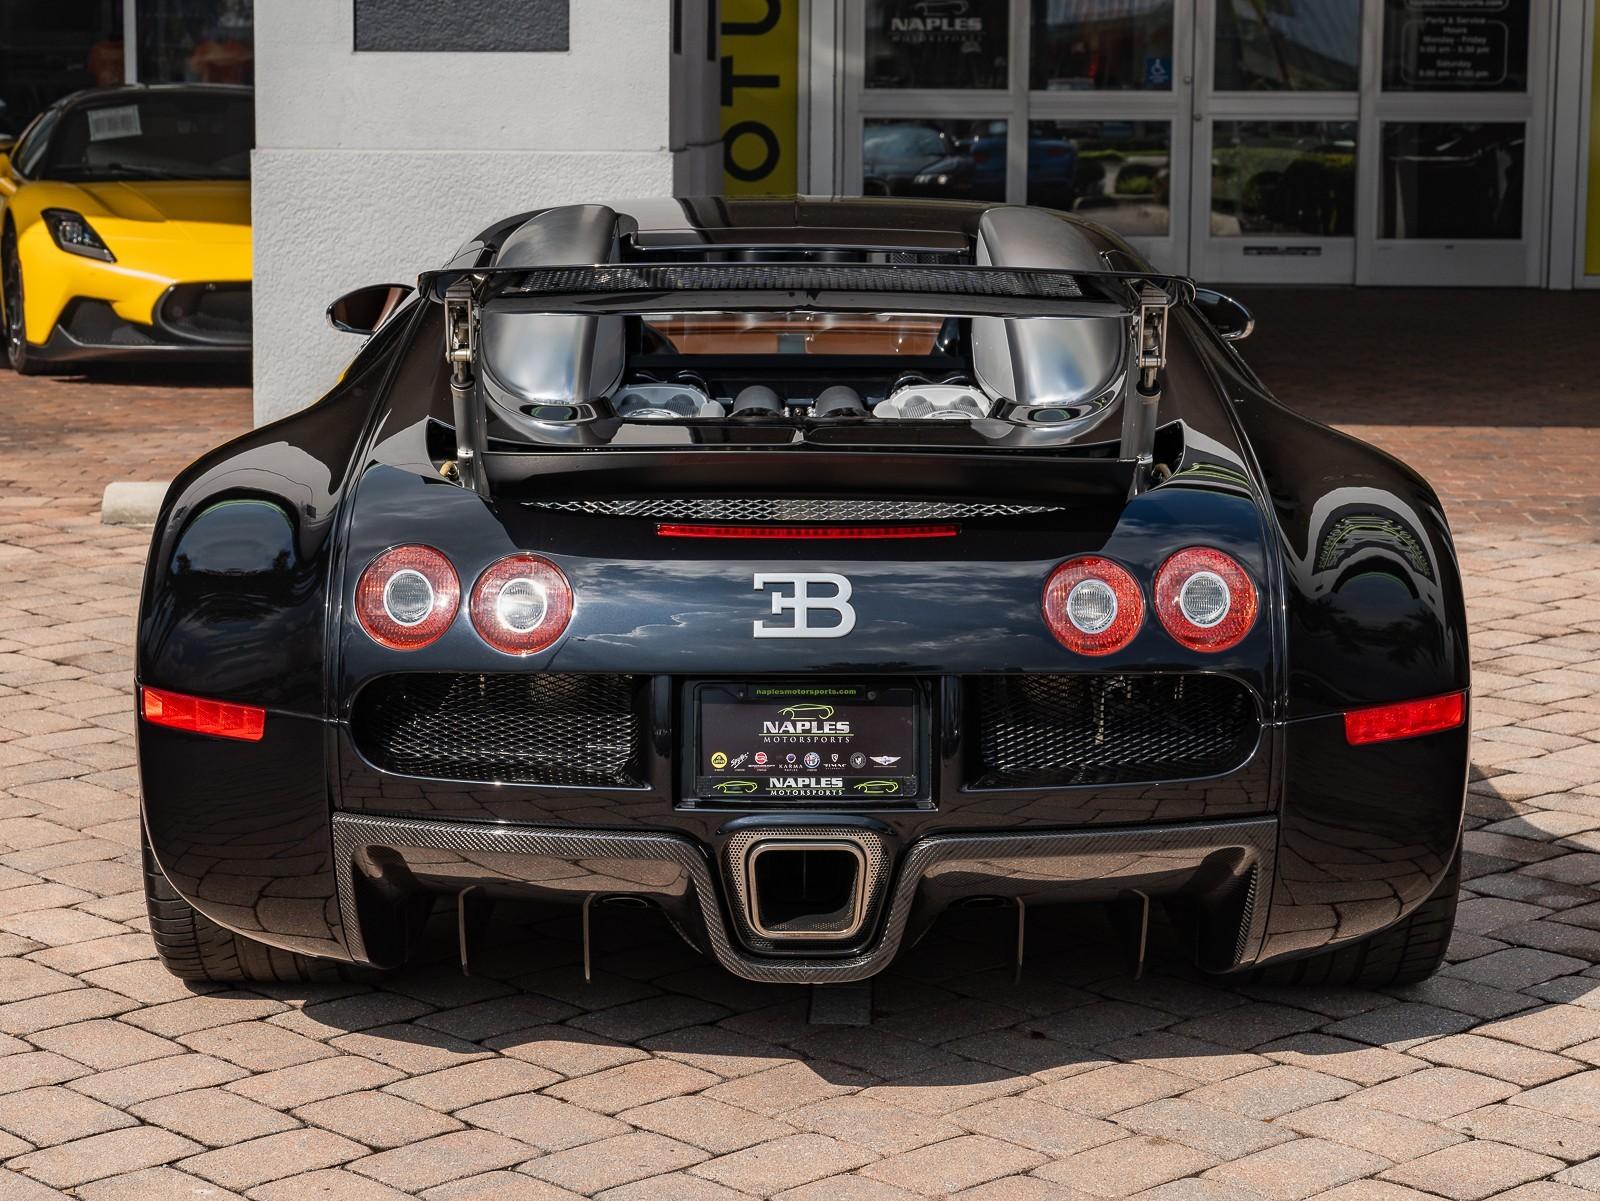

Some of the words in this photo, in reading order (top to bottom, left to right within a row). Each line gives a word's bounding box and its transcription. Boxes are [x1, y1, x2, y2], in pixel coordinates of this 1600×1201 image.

[891, 17, 982, 31] NAPLES
[1443, 26, 1468, 34] Hours
[1461, 36, 1487, 45] Friday
[1436, 59, 1472, 68] Saturday
[756, 688, 857, 696] naplesmotorsports.com
[763, 721, 850, 734] NAPLES
[769, 777, 843, 788] NAPLES
